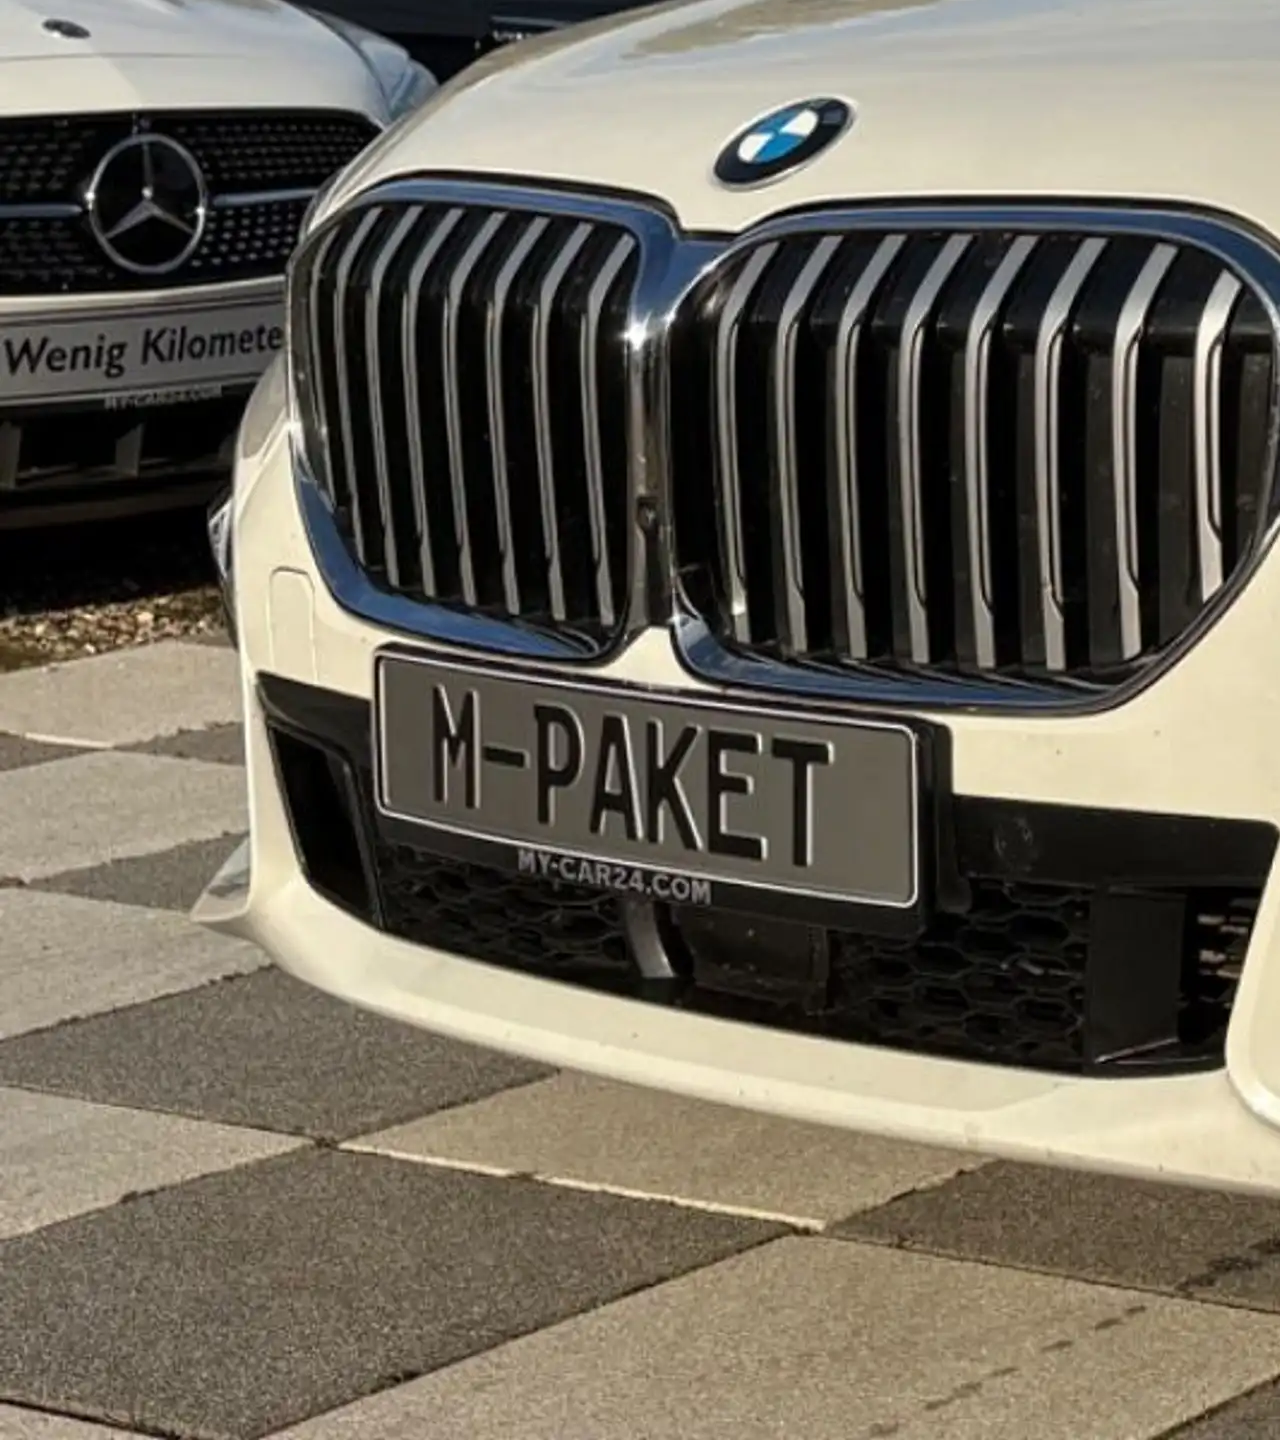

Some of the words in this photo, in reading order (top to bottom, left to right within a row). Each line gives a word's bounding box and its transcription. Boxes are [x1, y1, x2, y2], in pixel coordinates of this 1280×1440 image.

[4, 334, 128, 379] Wenig
[431, 683, 836, 869] M-PAKET
[517, 848, 712, 906] MY-CAR24.COM
